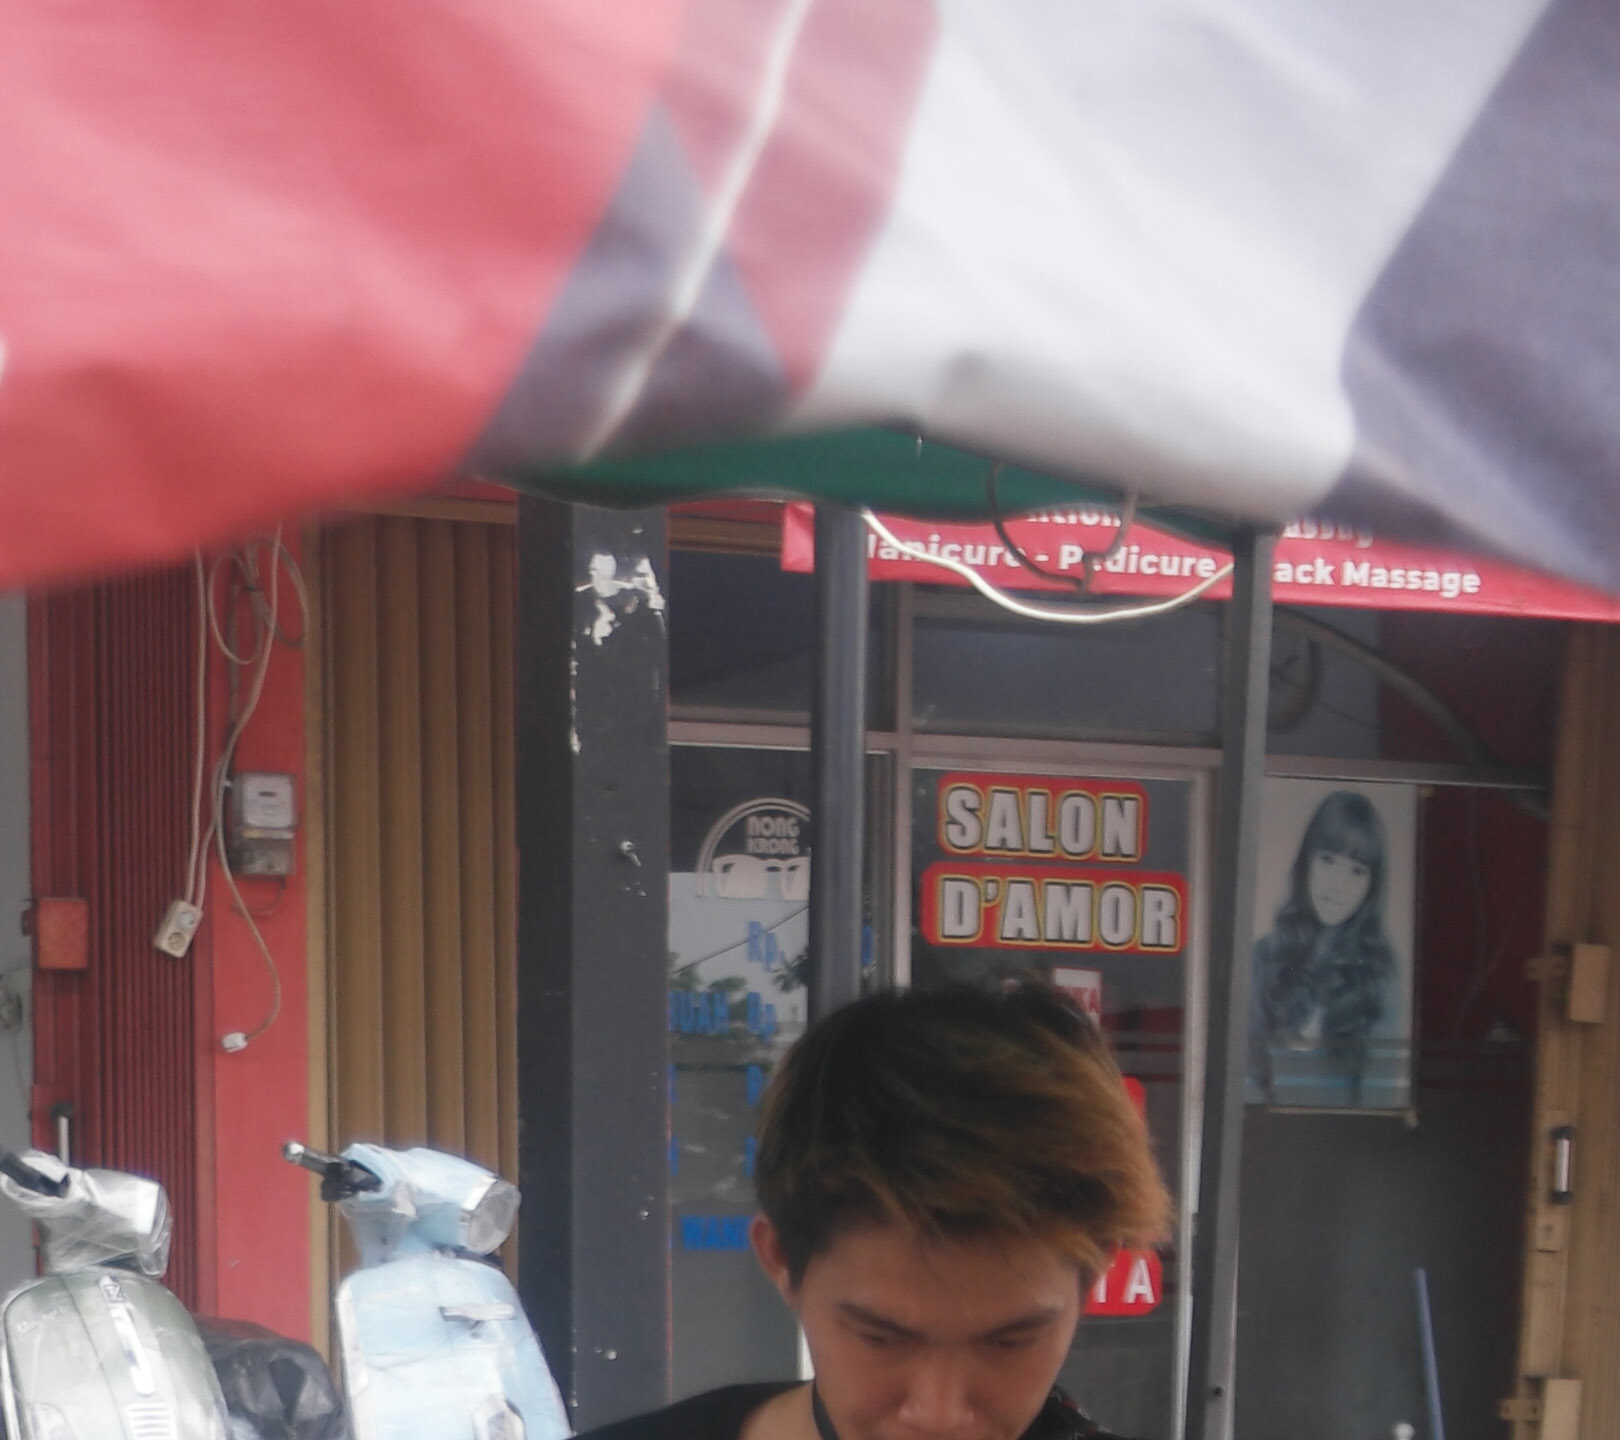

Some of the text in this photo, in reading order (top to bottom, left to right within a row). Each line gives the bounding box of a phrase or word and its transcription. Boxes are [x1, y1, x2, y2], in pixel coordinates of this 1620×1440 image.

[1061, 544, 1216, 578] Pdicure
[1274, 562, 1333, 585] ack
[1342, 563, 1481, 598] Massage
[945, 785, 1139, 858] SALON
[939, 875, 1180, 950] D'AMOR
